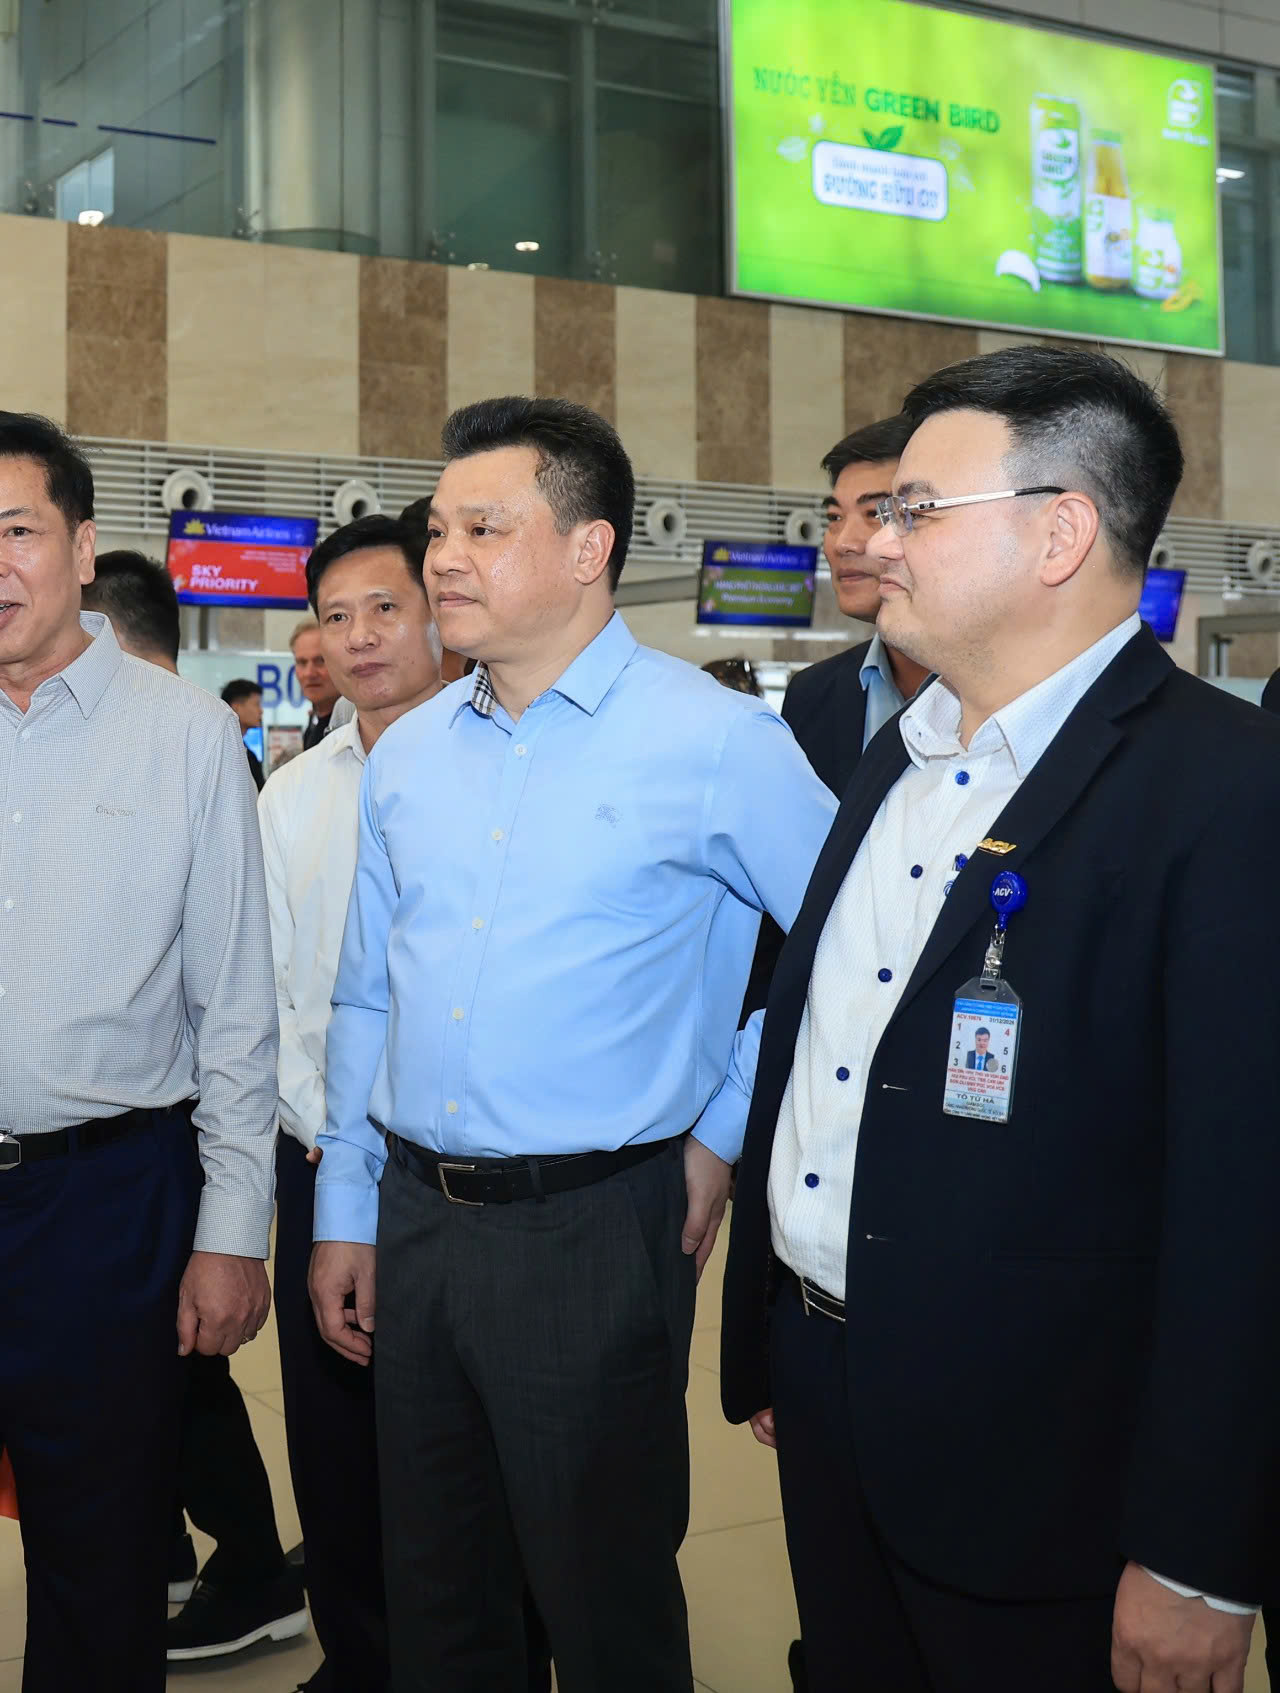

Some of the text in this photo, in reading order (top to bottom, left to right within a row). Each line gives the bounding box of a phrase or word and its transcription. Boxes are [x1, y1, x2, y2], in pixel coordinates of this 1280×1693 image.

[864, 87, 940, 123] GREEN
[949, 103, 1001, 134] BIRD
[190, 576, 259, 593] PRIORITY
[994, 887, 1011, 897] ACV
[955, 1040, 961, 1049] 2
[1003, 1046, 1009, 1056] 5
[1001, 1064, 1007, 1074] 6
